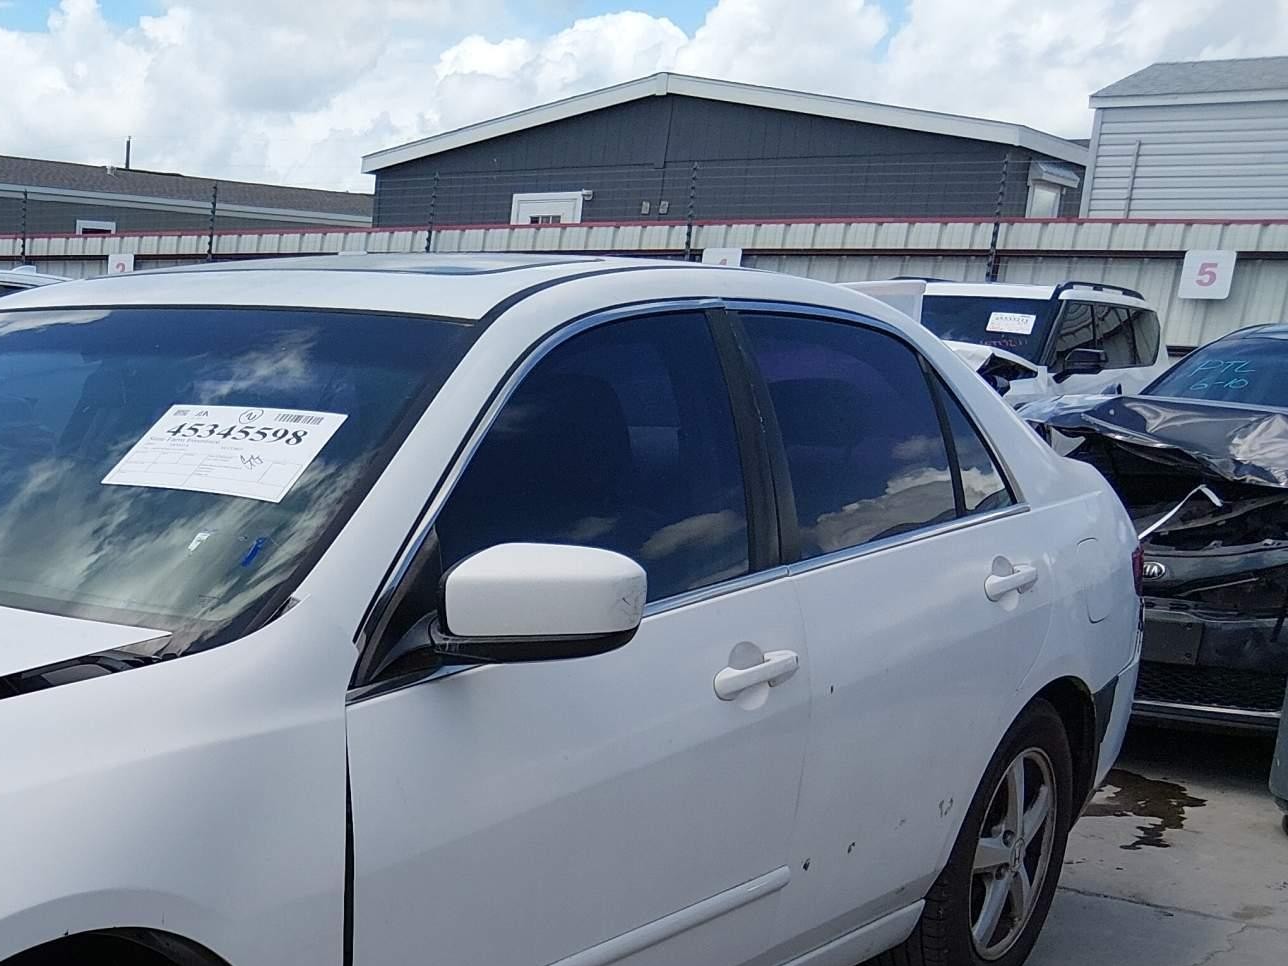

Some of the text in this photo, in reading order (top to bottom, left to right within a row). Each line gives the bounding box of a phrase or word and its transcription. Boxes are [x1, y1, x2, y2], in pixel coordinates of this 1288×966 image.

[1195, 262, 1219, 287] 5
[1190, 360, 1256, 377] PTL
[1189, 378, 1249, 391] 6-10
[166, 422, 309, 446] 45345598
